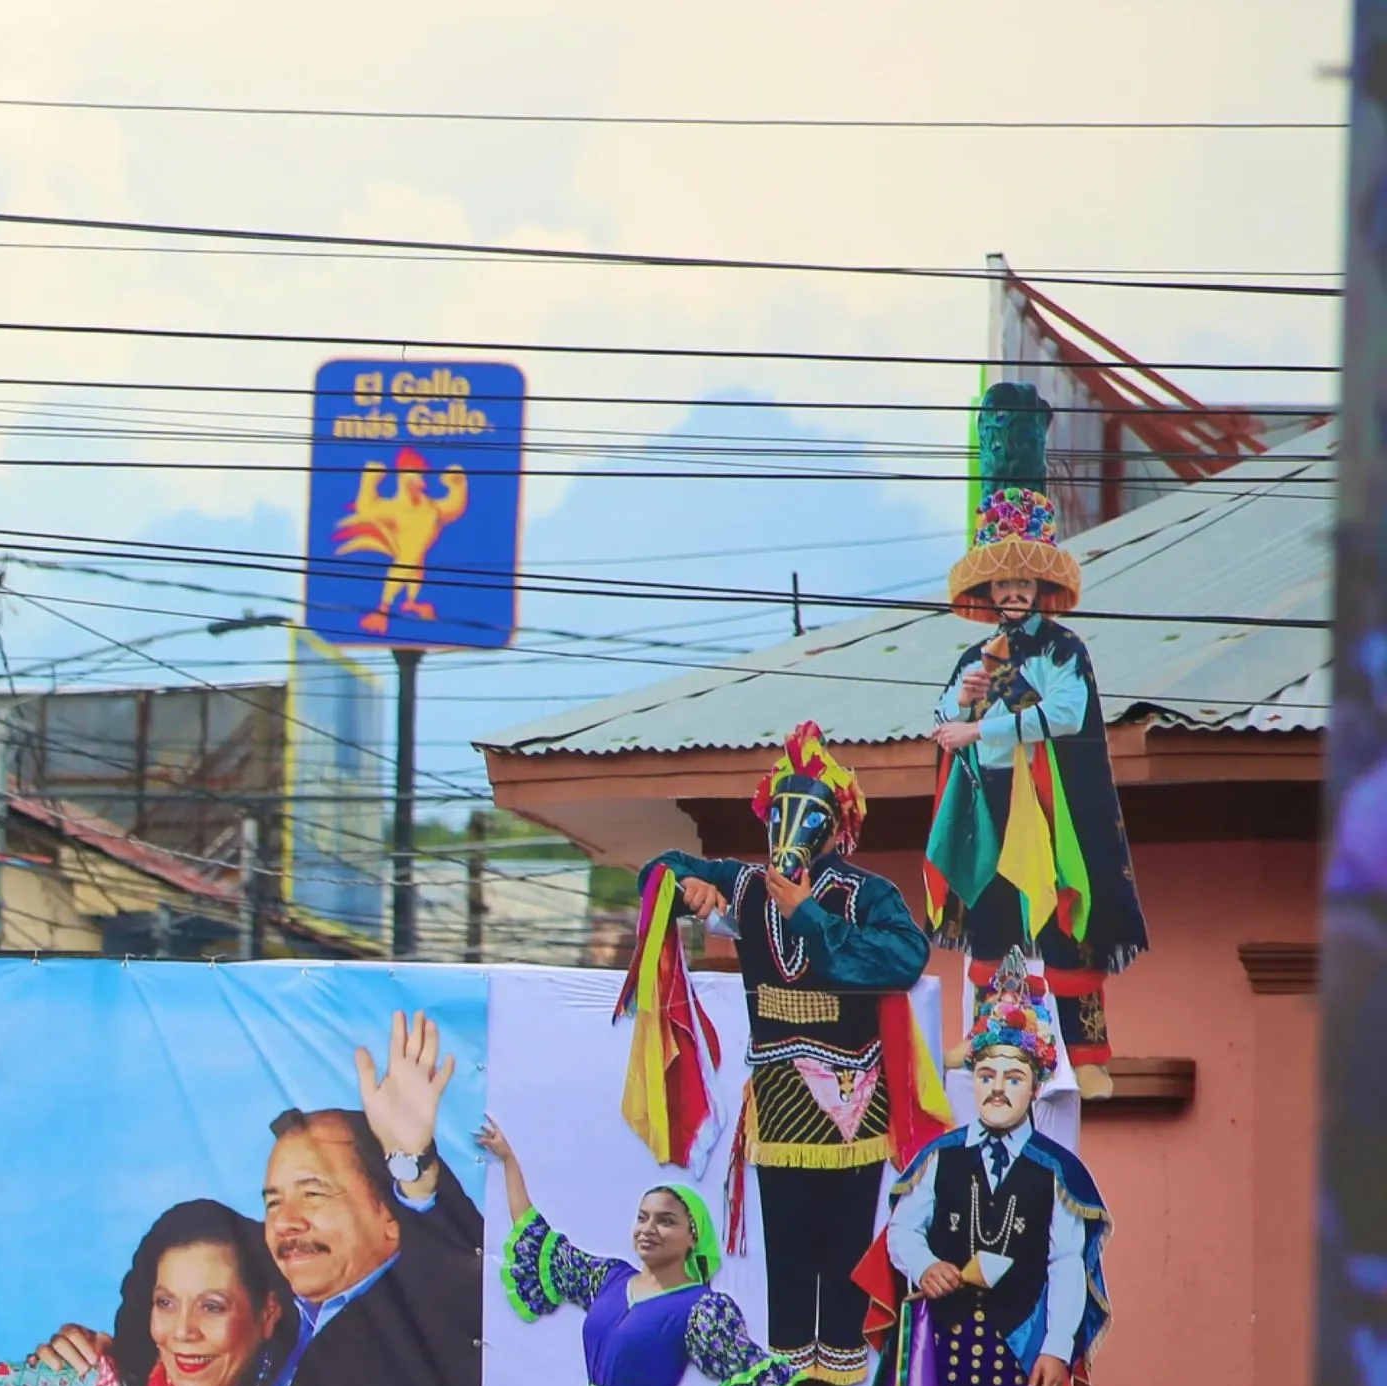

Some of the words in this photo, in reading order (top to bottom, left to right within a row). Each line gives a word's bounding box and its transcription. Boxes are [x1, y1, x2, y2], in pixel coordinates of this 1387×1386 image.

[354, 371, 383, 406] El
[391, 367, 471, 404] Gallo
[333, 408, 398, 438] más
